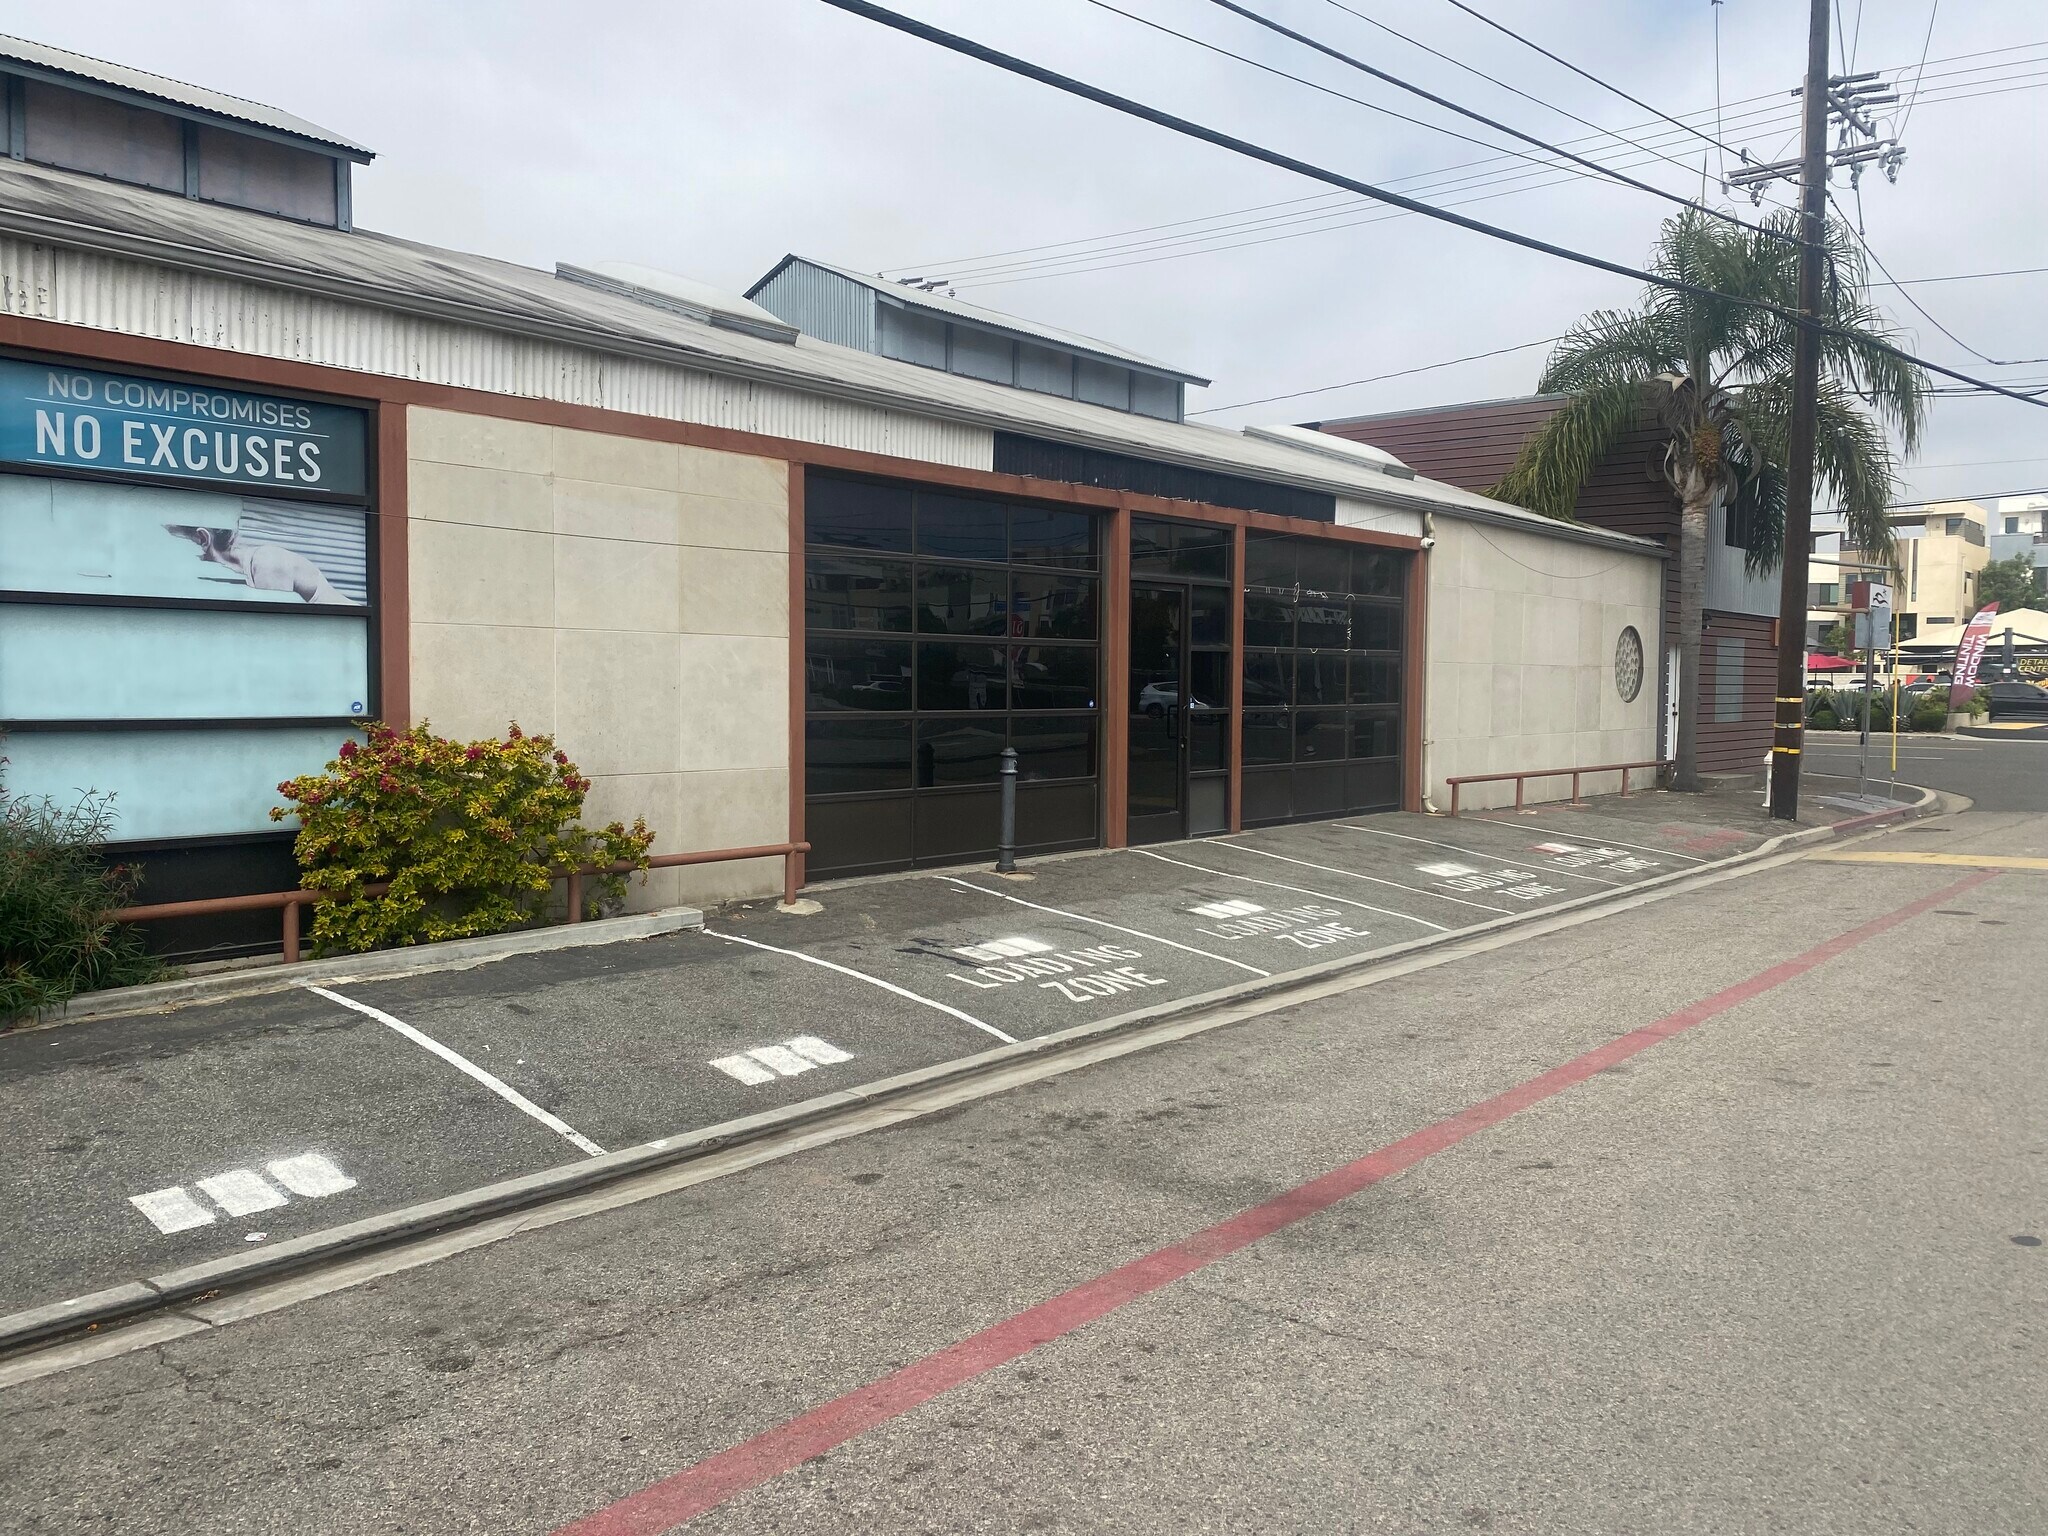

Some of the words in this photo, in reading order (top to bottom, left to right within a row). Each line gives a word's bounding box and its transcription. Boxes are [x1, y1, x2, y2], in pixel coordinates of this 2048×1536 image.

[48, 372, 93, 401] NO
[104, 380, 311, 429] COMPROMISES
[36, 409, 101, 460] NO
[123, 420, 321, 483] EXCUSES
[1954, 635, 1976, 685] TINTING
[1964, 633, 1990, 688] WINDOW
[2019, 658, 2048, 666] DETAI
[1544, 847, 1631, 868] LOADING
[1600, 857, 1660, 873] ZONE
[1432, 869, 1537, 892] LOADING
[1495, 882, 1566, 900] ZONE
[1195, 905, 1342, 940] LOADING
[1273, 922, 1371, 949] ZONE
[946, 945, 1142, 988] LOADING
[1038, 967, 1168, 1002] ZONE
